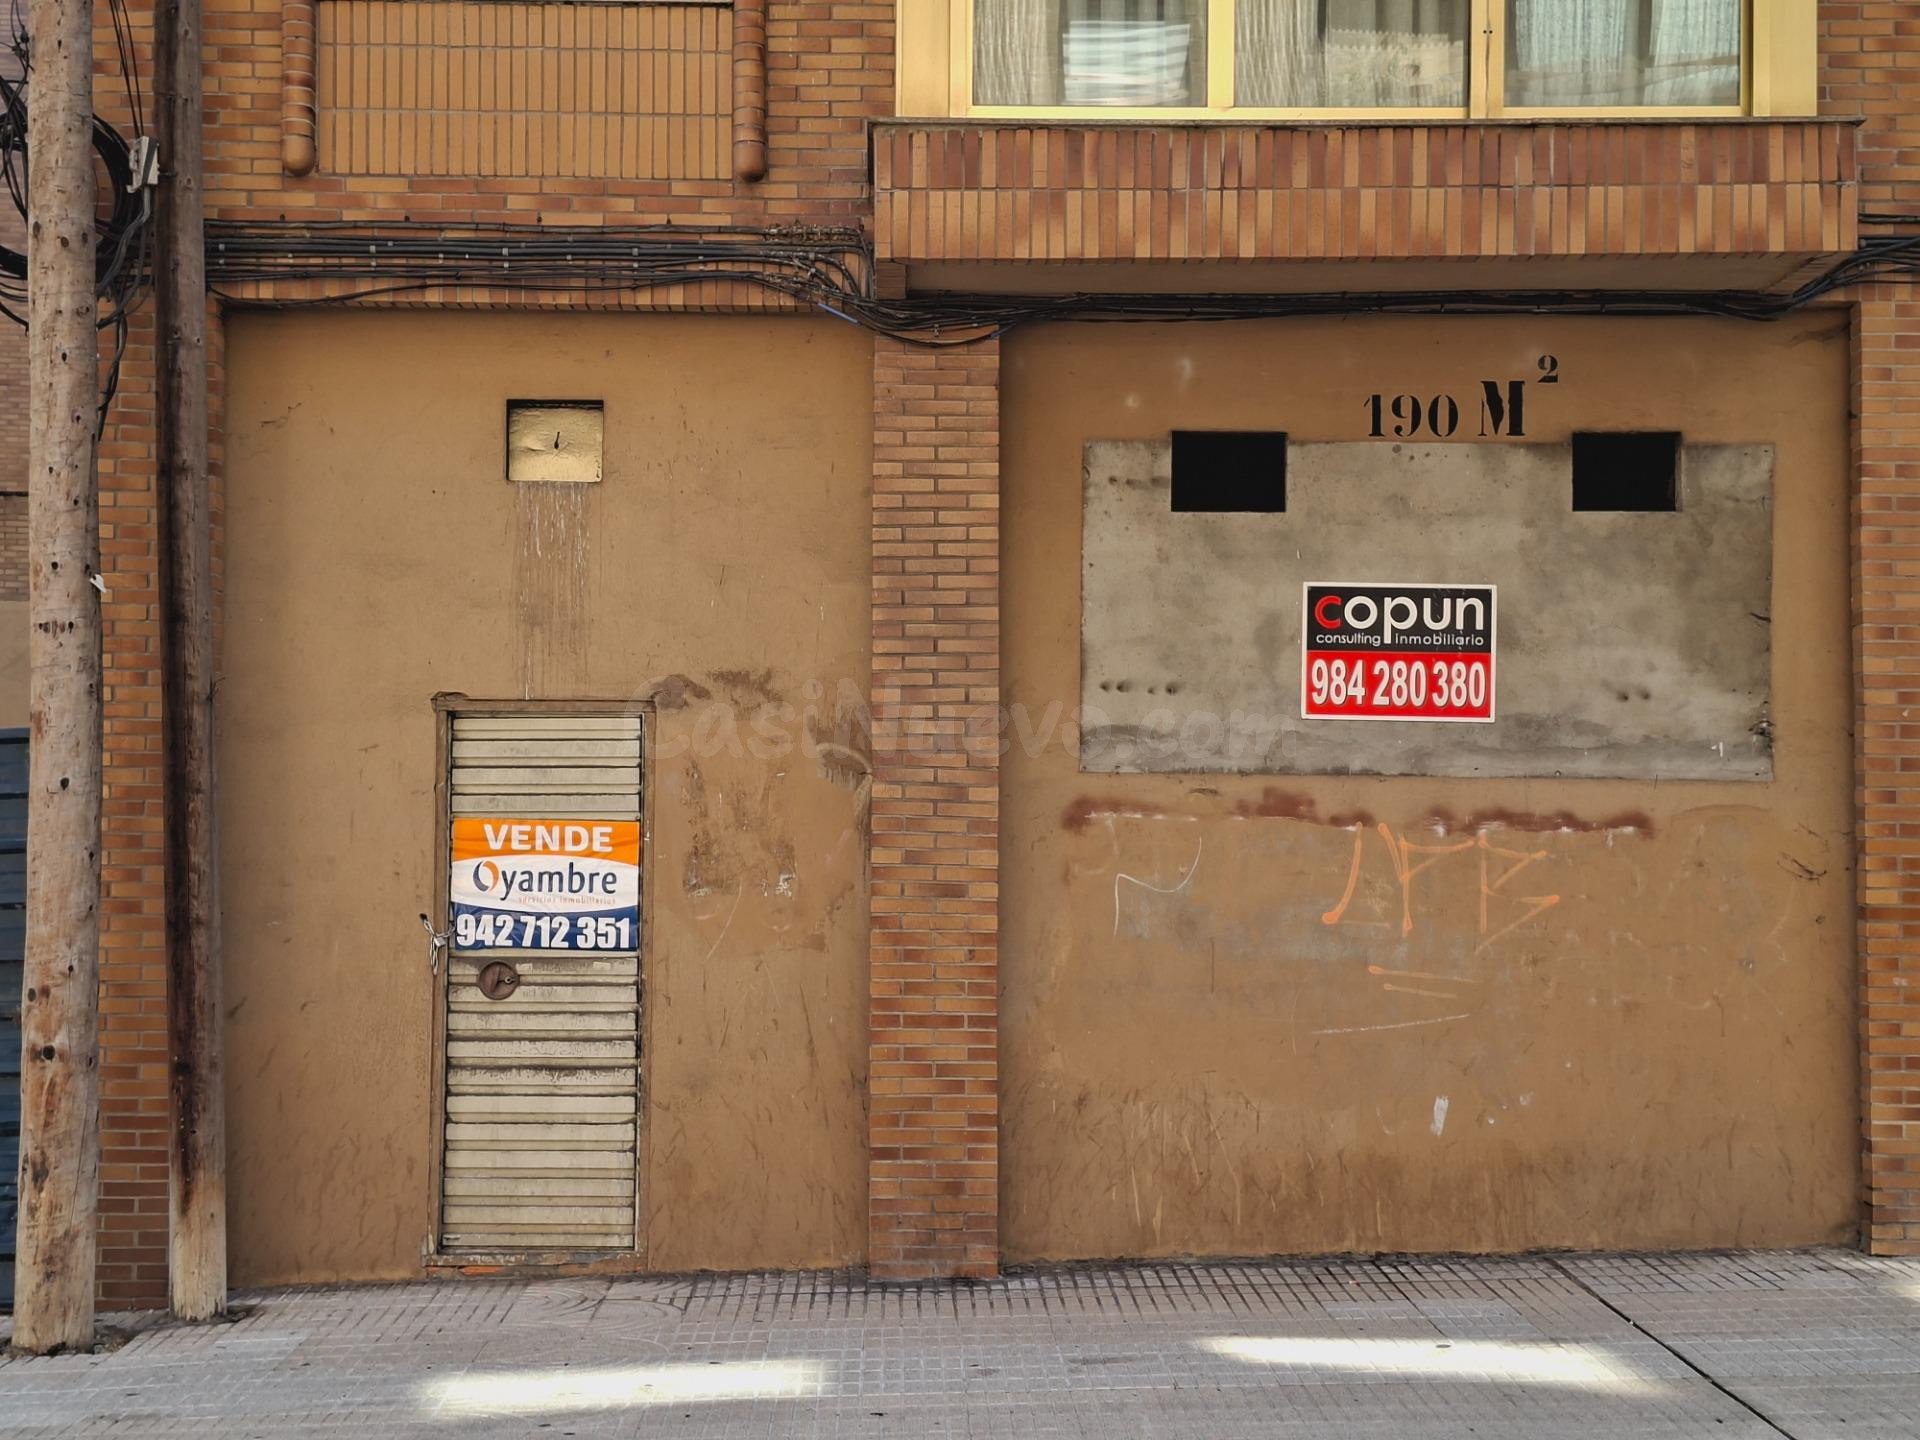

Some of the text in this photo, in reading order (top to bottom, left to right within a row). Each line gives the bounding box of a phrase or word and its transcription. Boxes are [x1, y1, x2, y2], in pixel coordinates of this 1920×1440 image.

[1363, 394, 1459, 437] 190
[1314, 595, 1484, 644] copun
[1315, 632, 1381, 647] consulting
[1311, 658, 1486, 707] 984 280 380
[483, 823, 613, 853] VENDE
[472, 860, 618, 901] Oyambre
[456, 913, 630, 949] 942 712 351
